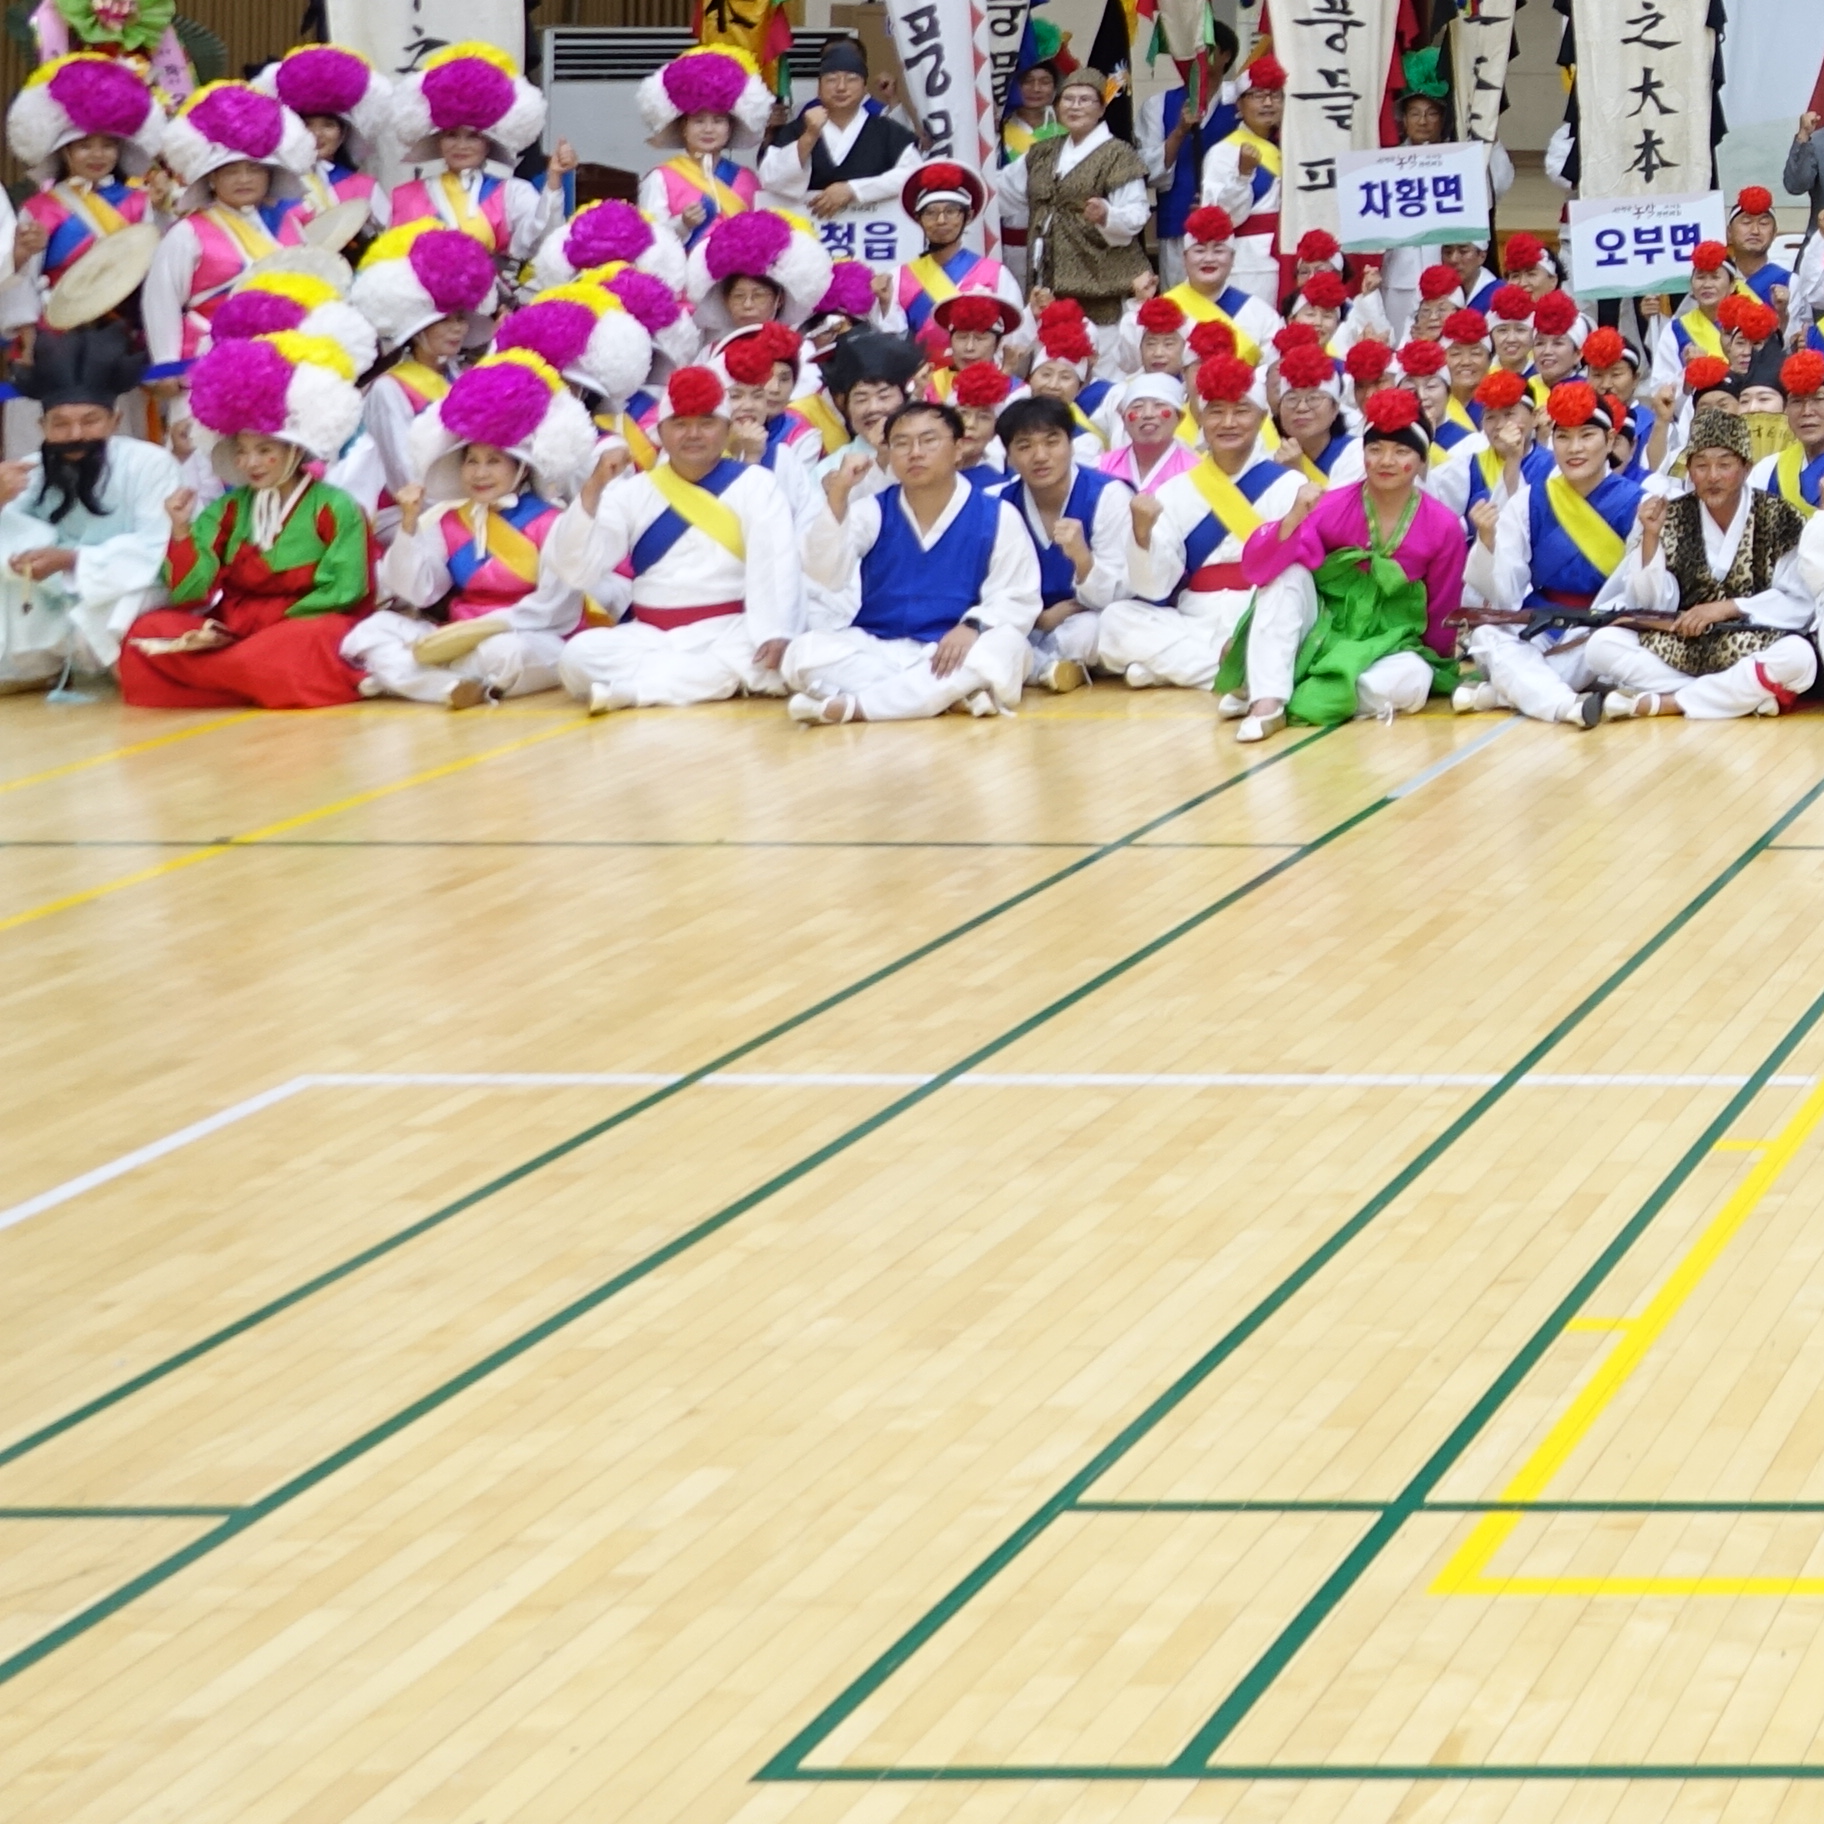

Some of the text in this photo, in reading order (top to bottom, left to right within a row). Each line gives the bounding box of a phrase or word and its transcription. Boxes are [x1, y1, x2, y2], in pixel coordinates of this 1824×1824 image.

[1358, 174, 1465, 219] 차황면
[812, 220, 898, 261] 청읍
[1595, 222, 1702, 267] 오부면
